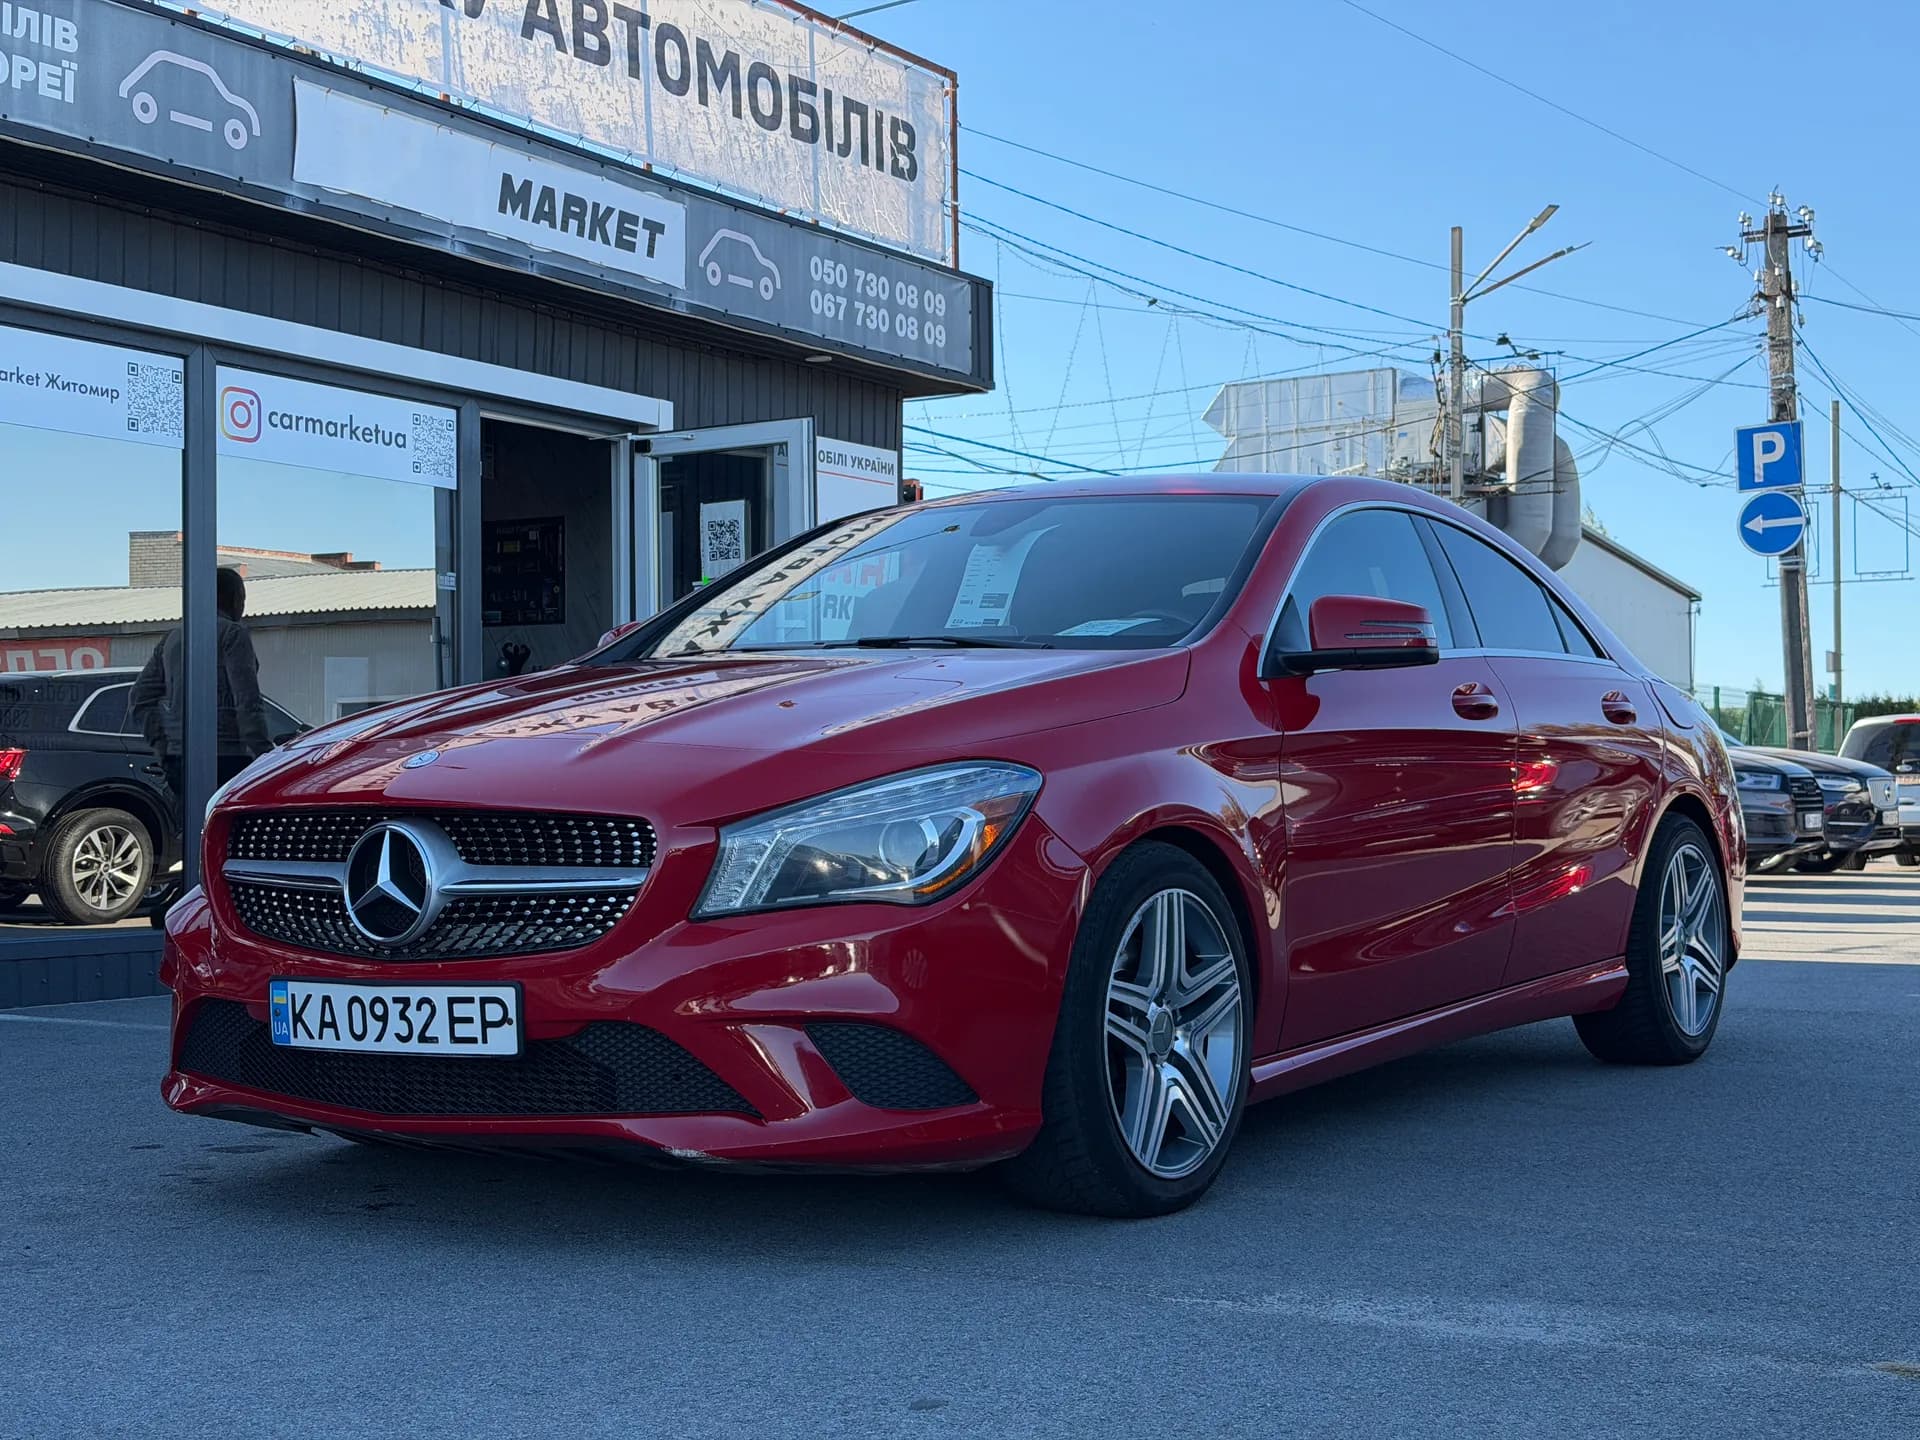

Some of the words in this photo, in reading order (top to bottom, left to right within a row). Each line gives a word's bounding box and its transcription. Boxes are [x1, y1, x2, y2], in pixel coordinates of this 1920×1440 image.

[520, 0, 919, 183] АВТОМОБІЛІВ
[497, 172, 666, 259] MARKET
[810, 255, 848, 289] 050
[854, 268, 890, 301] 730
[895, 281, 919, 309] 08
[923, 289, 946, 317] 09
[810, 289, 848, 321] 067
[854, 301, 890, 333] 730
[895, 313, 919, 341] 08
[923, 321, 946, 348] 09
[44, 372, 120, 404] Житомир
[268, 408, 407, 450] carmarketua
[850, 455, 895, 476] УКРАЇНИ
[1752, 431, 1786, 483] P
[274, 1021, 289, 1036] UA
